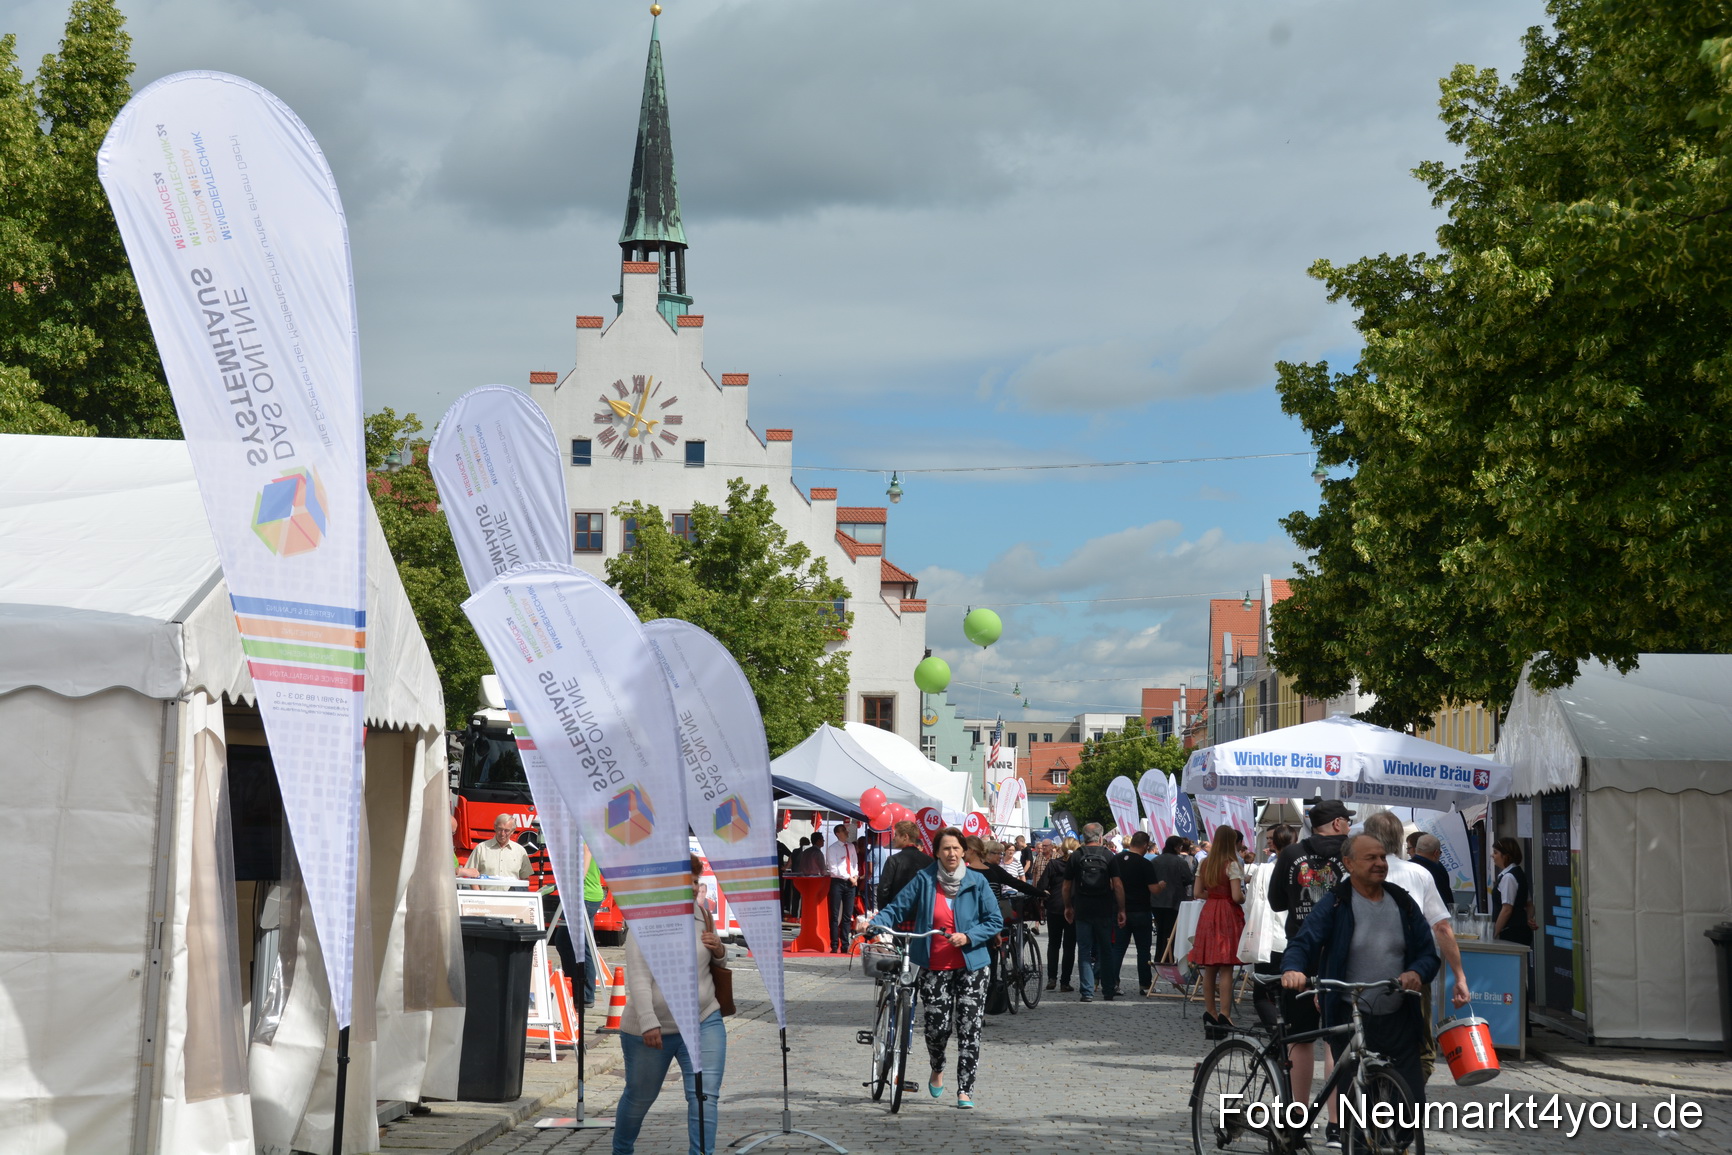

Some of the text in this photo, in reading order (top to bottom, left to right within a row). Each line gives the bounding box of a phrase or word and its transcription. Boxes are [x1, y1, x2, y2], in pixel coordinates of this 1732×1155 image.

[1234, 751, 1322, 769] Winkler Bräu
[1383, 759, 1437, 778] Winkler
[1439, 764, 1471, 782] Bräu
[926, 815, 939, 825] 48
[967, 818, 977, 829] 48
[1484, 991, 1502, 1002] Bräu
